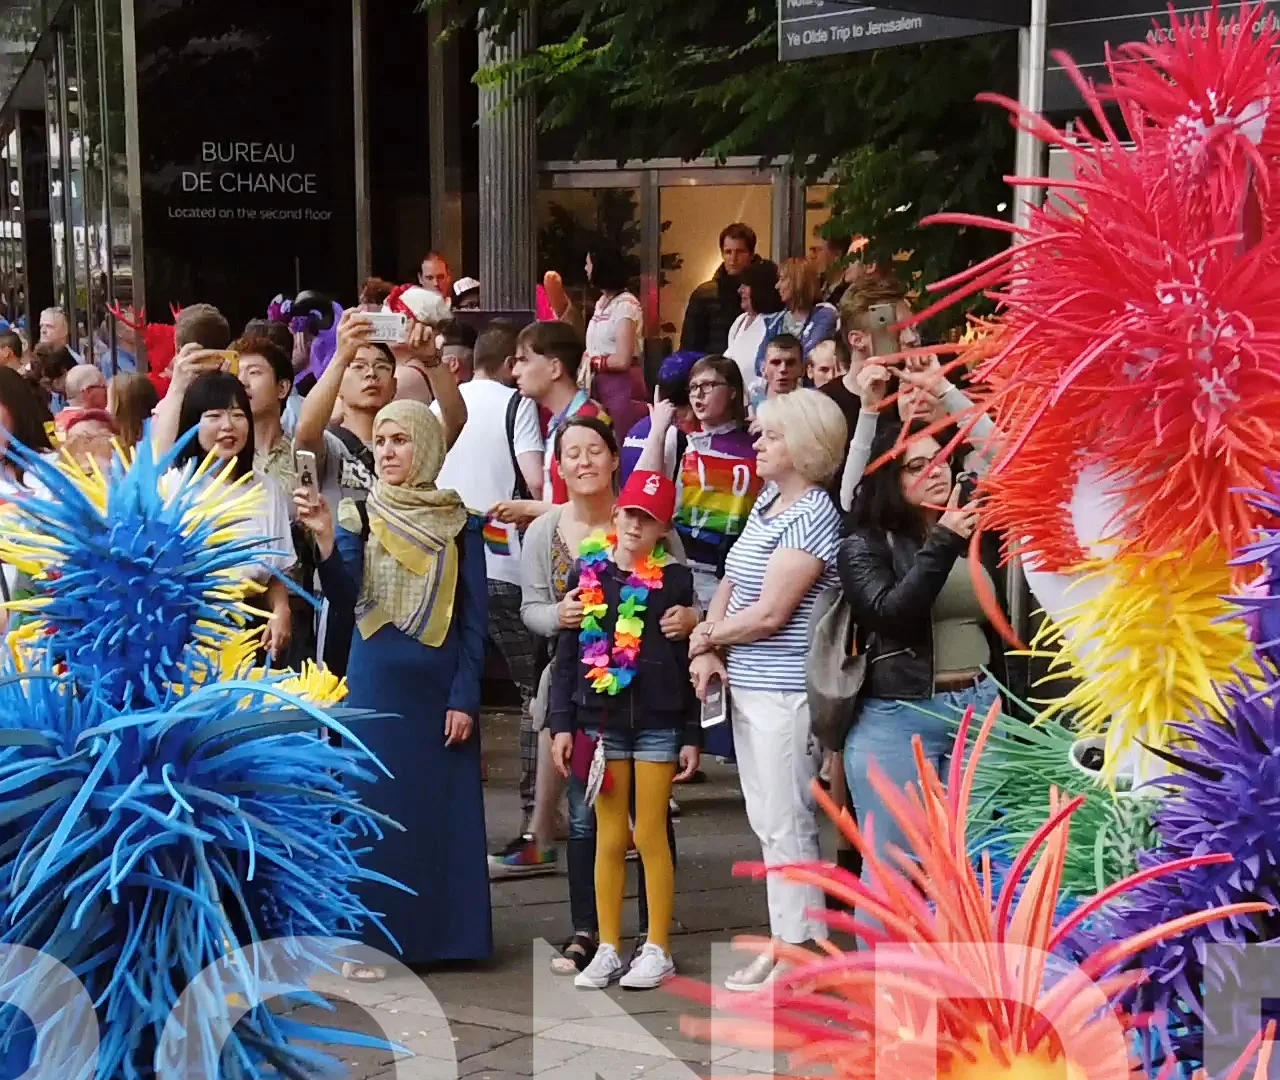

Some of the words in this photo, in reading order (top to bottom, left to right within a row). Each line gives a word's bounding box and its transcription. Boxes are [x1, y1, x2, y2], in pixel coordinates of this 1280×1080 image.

[787, 34, 801, 46] Ye
[802, 29, 828, 44] Olde
[830, 26, 851, 42] Trip
[852, 24, 864, 37] to
[865, 16, 923, 36] Jerusalem
[201, 141, 295, 163] BUREAU
[181, 171, 213, 192] DE
[219, 172, 318, 194] CHANGE
[168, 206, 216, 219] Located
[219, 209, 234, 219] on
[237, 207, 257, 219] the
[259, 207, 302, 220] second
[304, 208, 333, 220] floor
